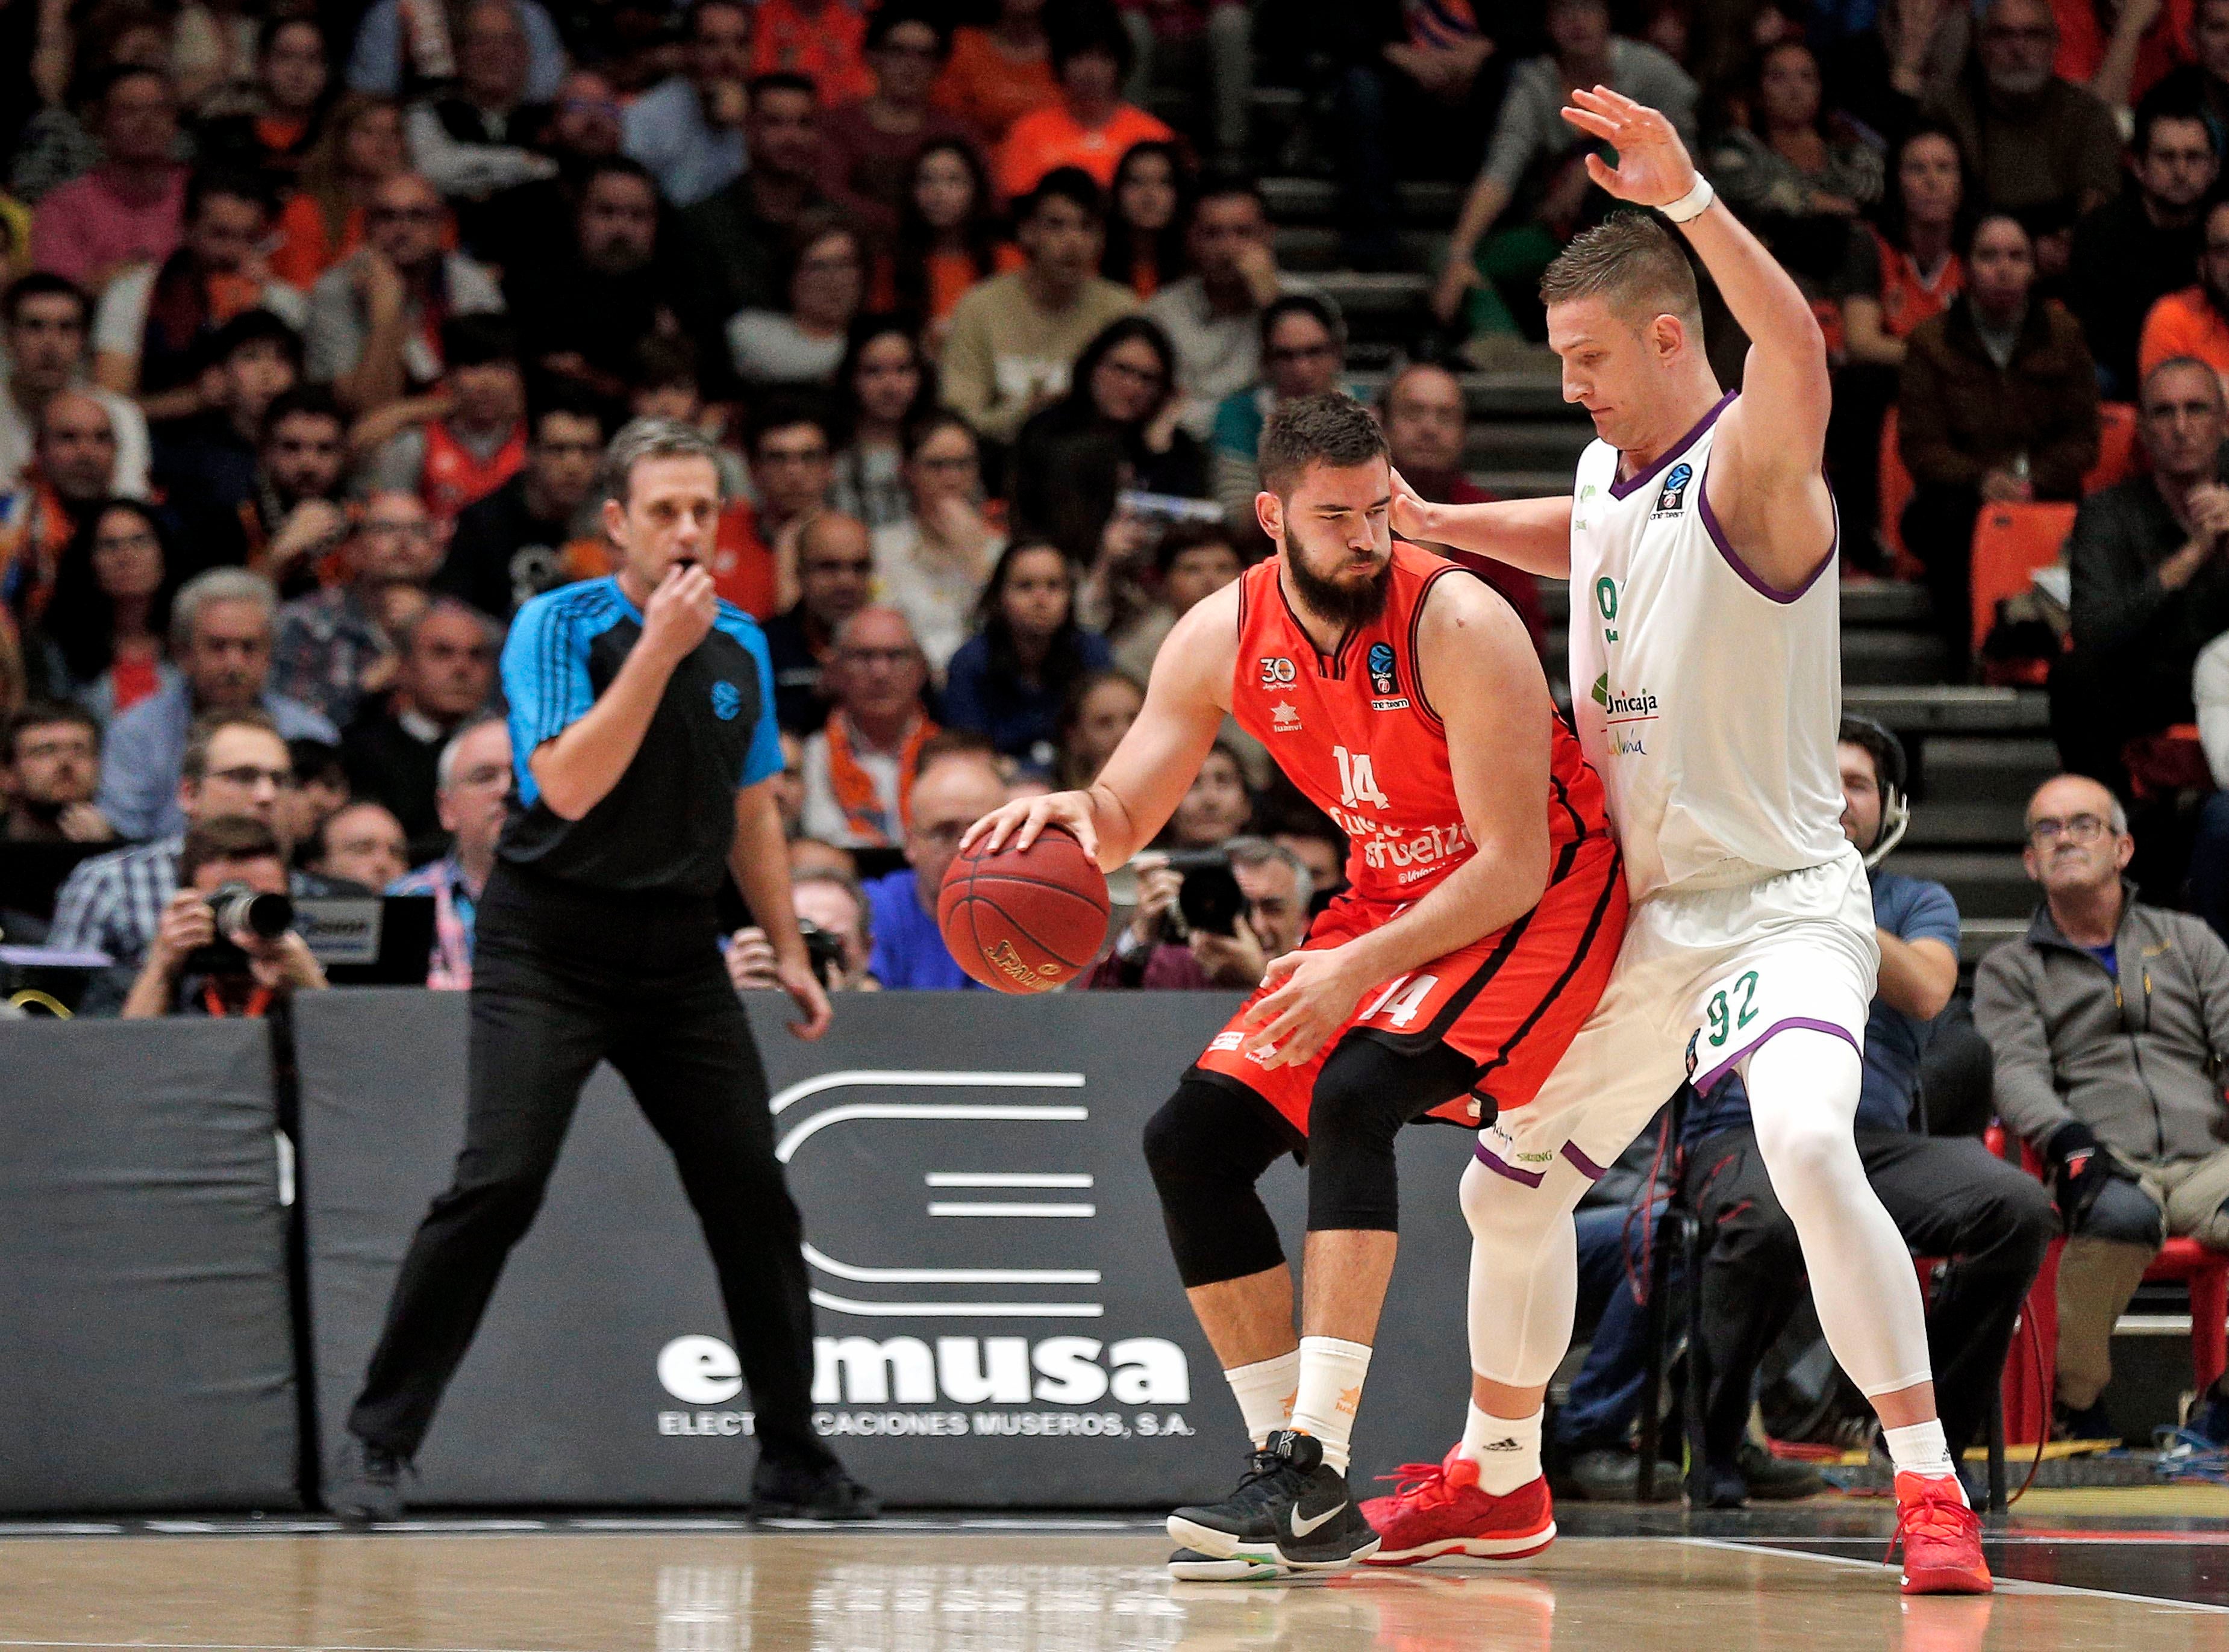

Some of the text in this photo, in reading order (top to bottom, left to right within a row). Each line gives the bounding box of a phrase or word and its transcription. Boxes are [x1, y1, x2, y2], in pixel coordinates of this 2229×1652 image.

[1260, 657, 1297, 682] 30
[1274, 722, 1303, 732] luanvi
[1332, 746, 1390, 809] 14
[1358, 974, 1439, 1027] 14
[1707, 970, 1759, 1047] 92
[657, 1333, 1191, 1405] emusa
[658, 1410, 969, 1437] ELECTCACIONES
[972, 1411, 1131, 1439] MUSEROS,
